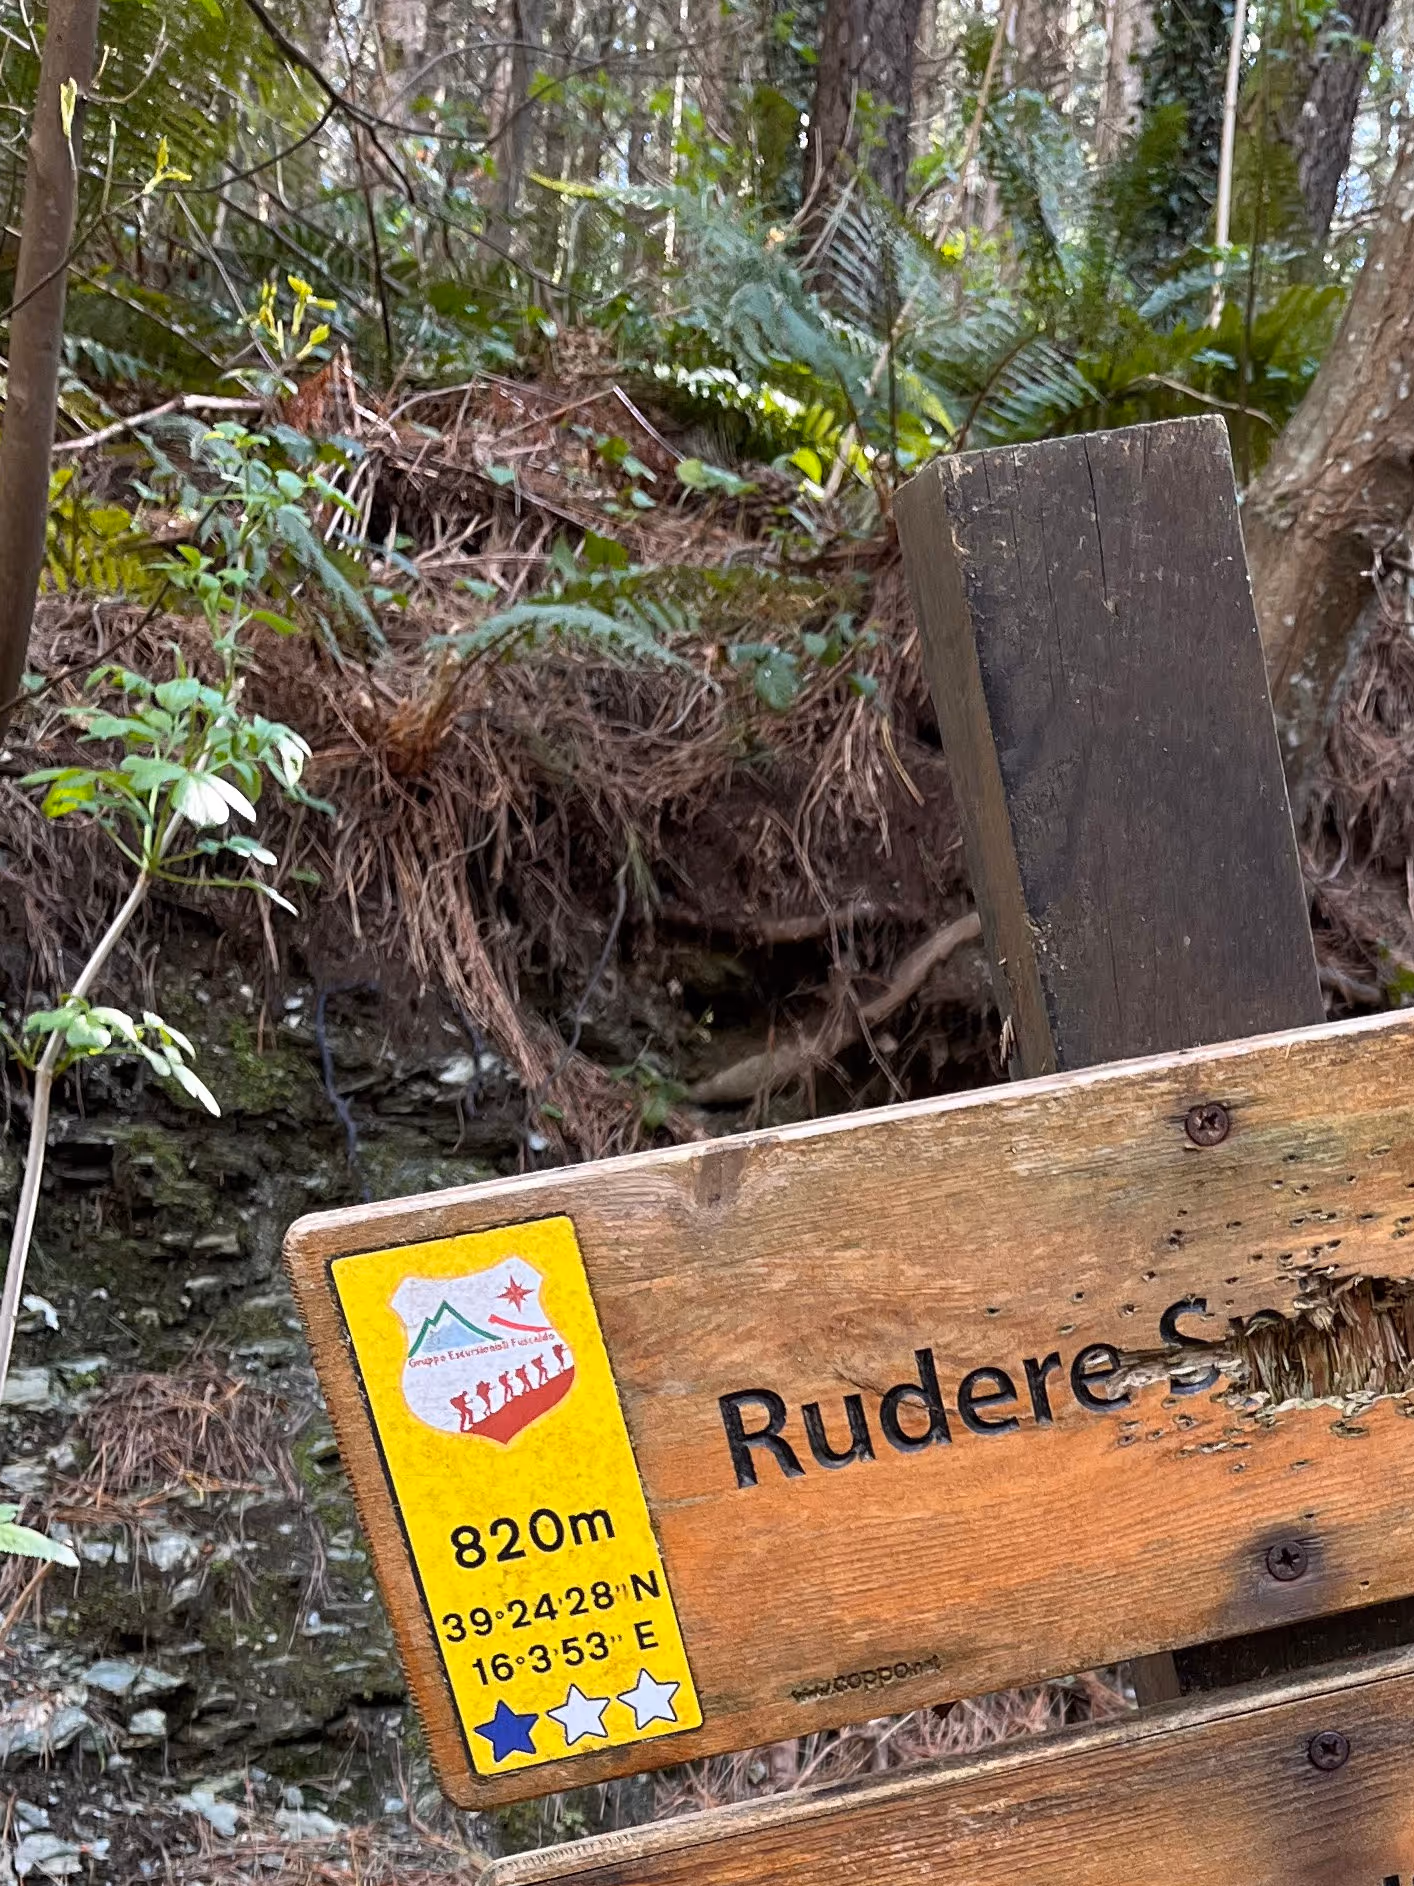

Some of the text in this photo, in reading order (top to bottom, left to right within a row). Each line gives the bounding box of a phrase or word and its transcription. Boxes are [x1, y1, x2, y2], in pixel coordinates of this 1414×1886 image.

[408, 1353, 447, 1369] Gruppo
[719, 1341, 1132, 1489] Rudere
[450, 1506, 616, 1570] 820m
[633, 1620, 659, 1650] E
